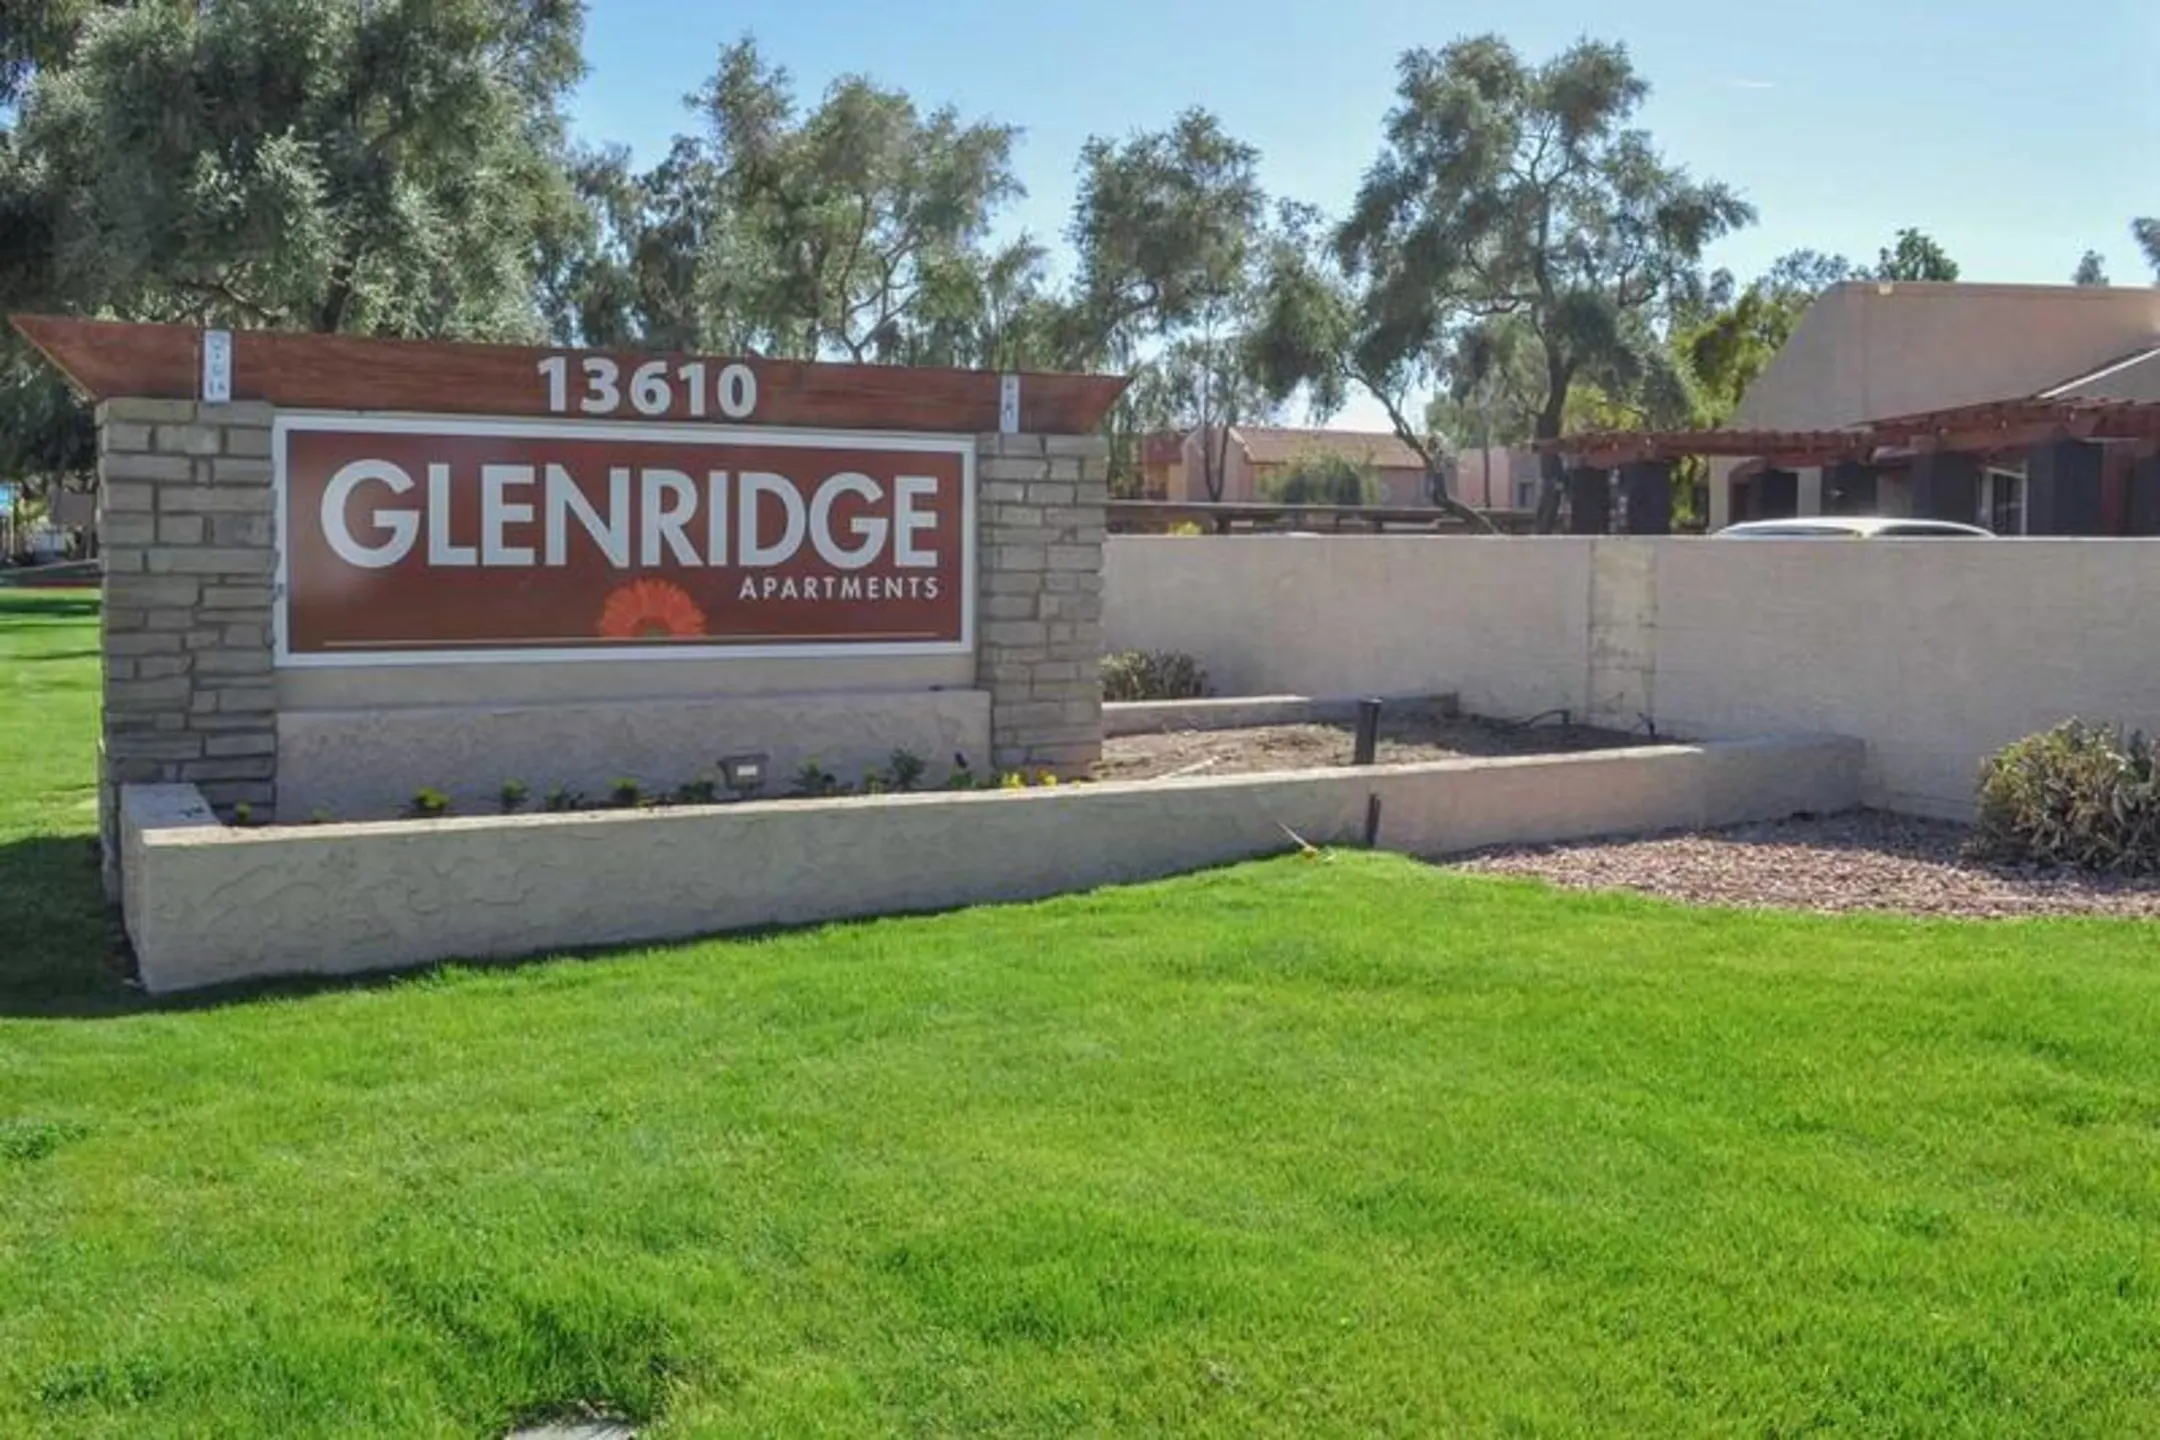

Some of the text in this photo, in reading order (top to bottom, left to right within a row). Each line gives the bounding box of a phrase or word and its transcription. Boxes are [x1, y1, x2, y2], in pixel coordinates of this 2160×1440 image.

[538, 357, 757, 418] 13610
[319, 458, 939, 569] GLENRIDGE
[738, 576, 940, 600] APARTMENTS
